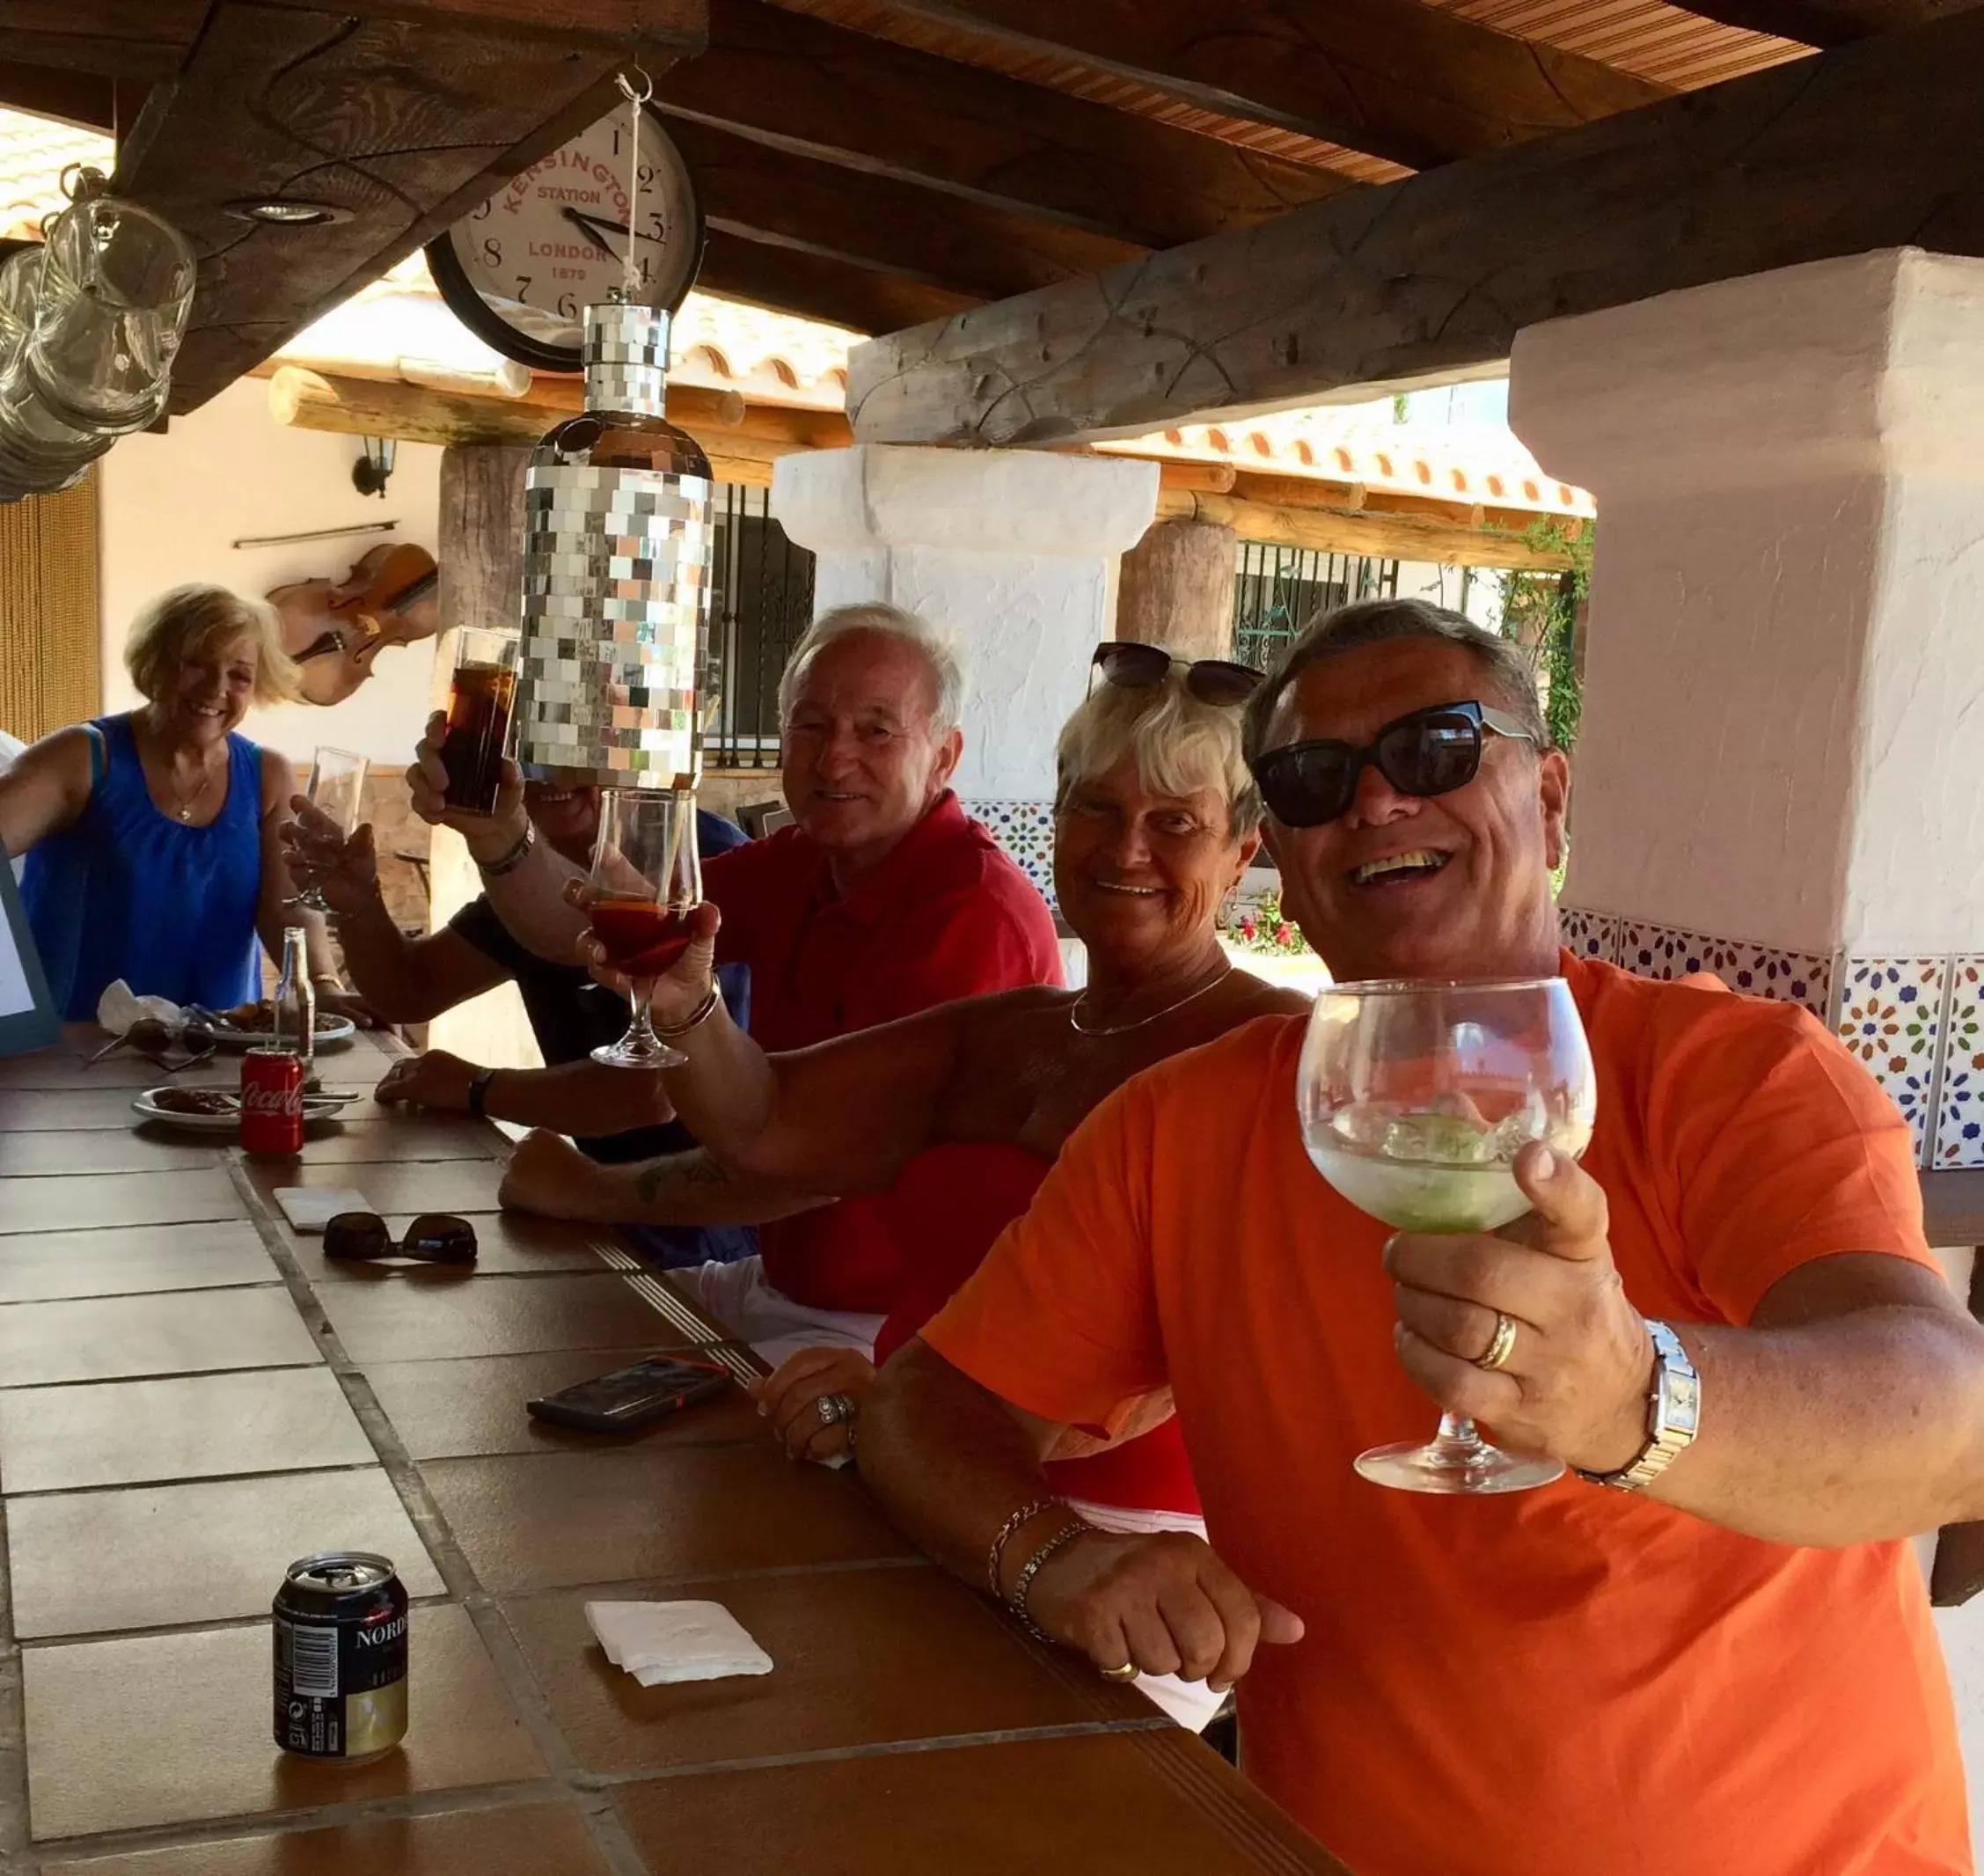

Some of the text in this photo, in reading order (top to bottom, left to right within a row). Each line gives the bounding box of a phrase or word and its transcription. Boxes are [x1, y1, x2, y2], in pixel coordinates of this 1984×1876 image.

[613, 129, 619, 157] 1
[637, 165, 655, 194] 2
[537, 186, 601, 204] STATION
[647, 212, 665, 240] 3
[484, 238, 501, 268] 8
[528, 241, 607, 262] LONDON
[552, 266, 587, 281] 1879
[516, 275, 531, 304] 7
[558, 292, 578, 320] 6
